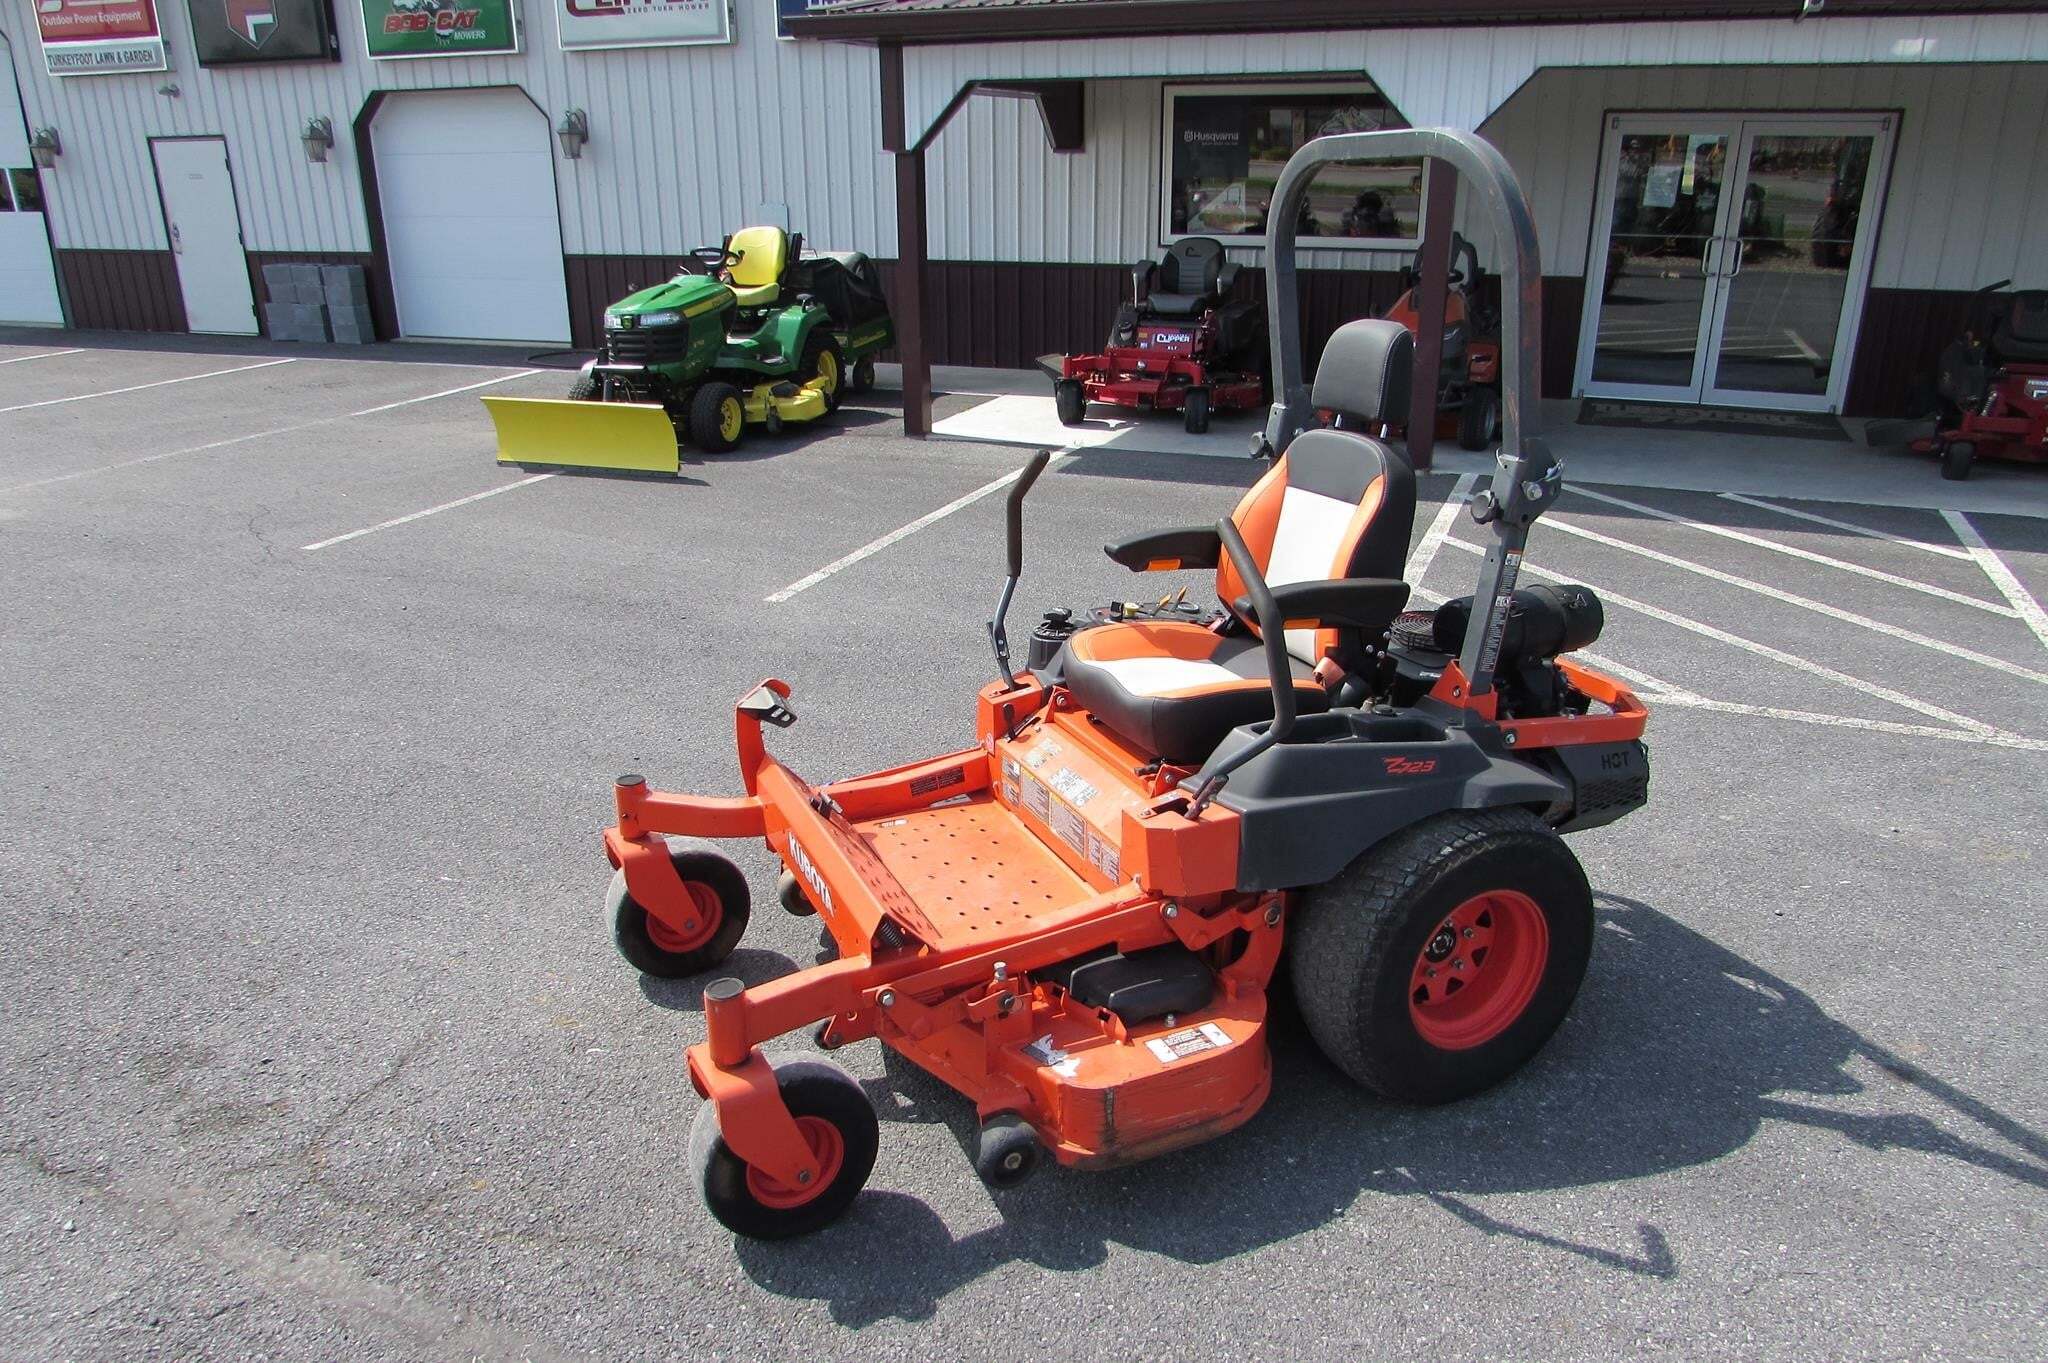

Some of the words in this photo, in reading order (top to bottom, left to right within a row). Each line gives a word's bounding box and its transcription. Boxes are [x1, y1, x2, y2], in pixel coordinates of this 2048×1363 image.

[41, 15, 73, 26] Outdoor
[74, 13, 98, 24] Power
[98, 10, 142, 25] Equipment
[627, 6, 649, 14] ZERO
[653, 5, 673, 13] TURN
[678, 4, 710, 12] MOWER
[384, 9, 480, 33] BOB-CAT
[454, 30, 486, 40] MOWERS
[47, 51, 93, 67] TURKEYFOOT
[94, 50, 115, 64] LAWN
[115, 50, 122, 64] &
[123, 48, 155, 63] GARDEN
[1193, 131, 1239, 142] Husqvarna
[1382, 755, 1437, 774] Z723
[1601, 751, 1630, 769] HOT
[788, 831, 836, 918] KUBOTA
